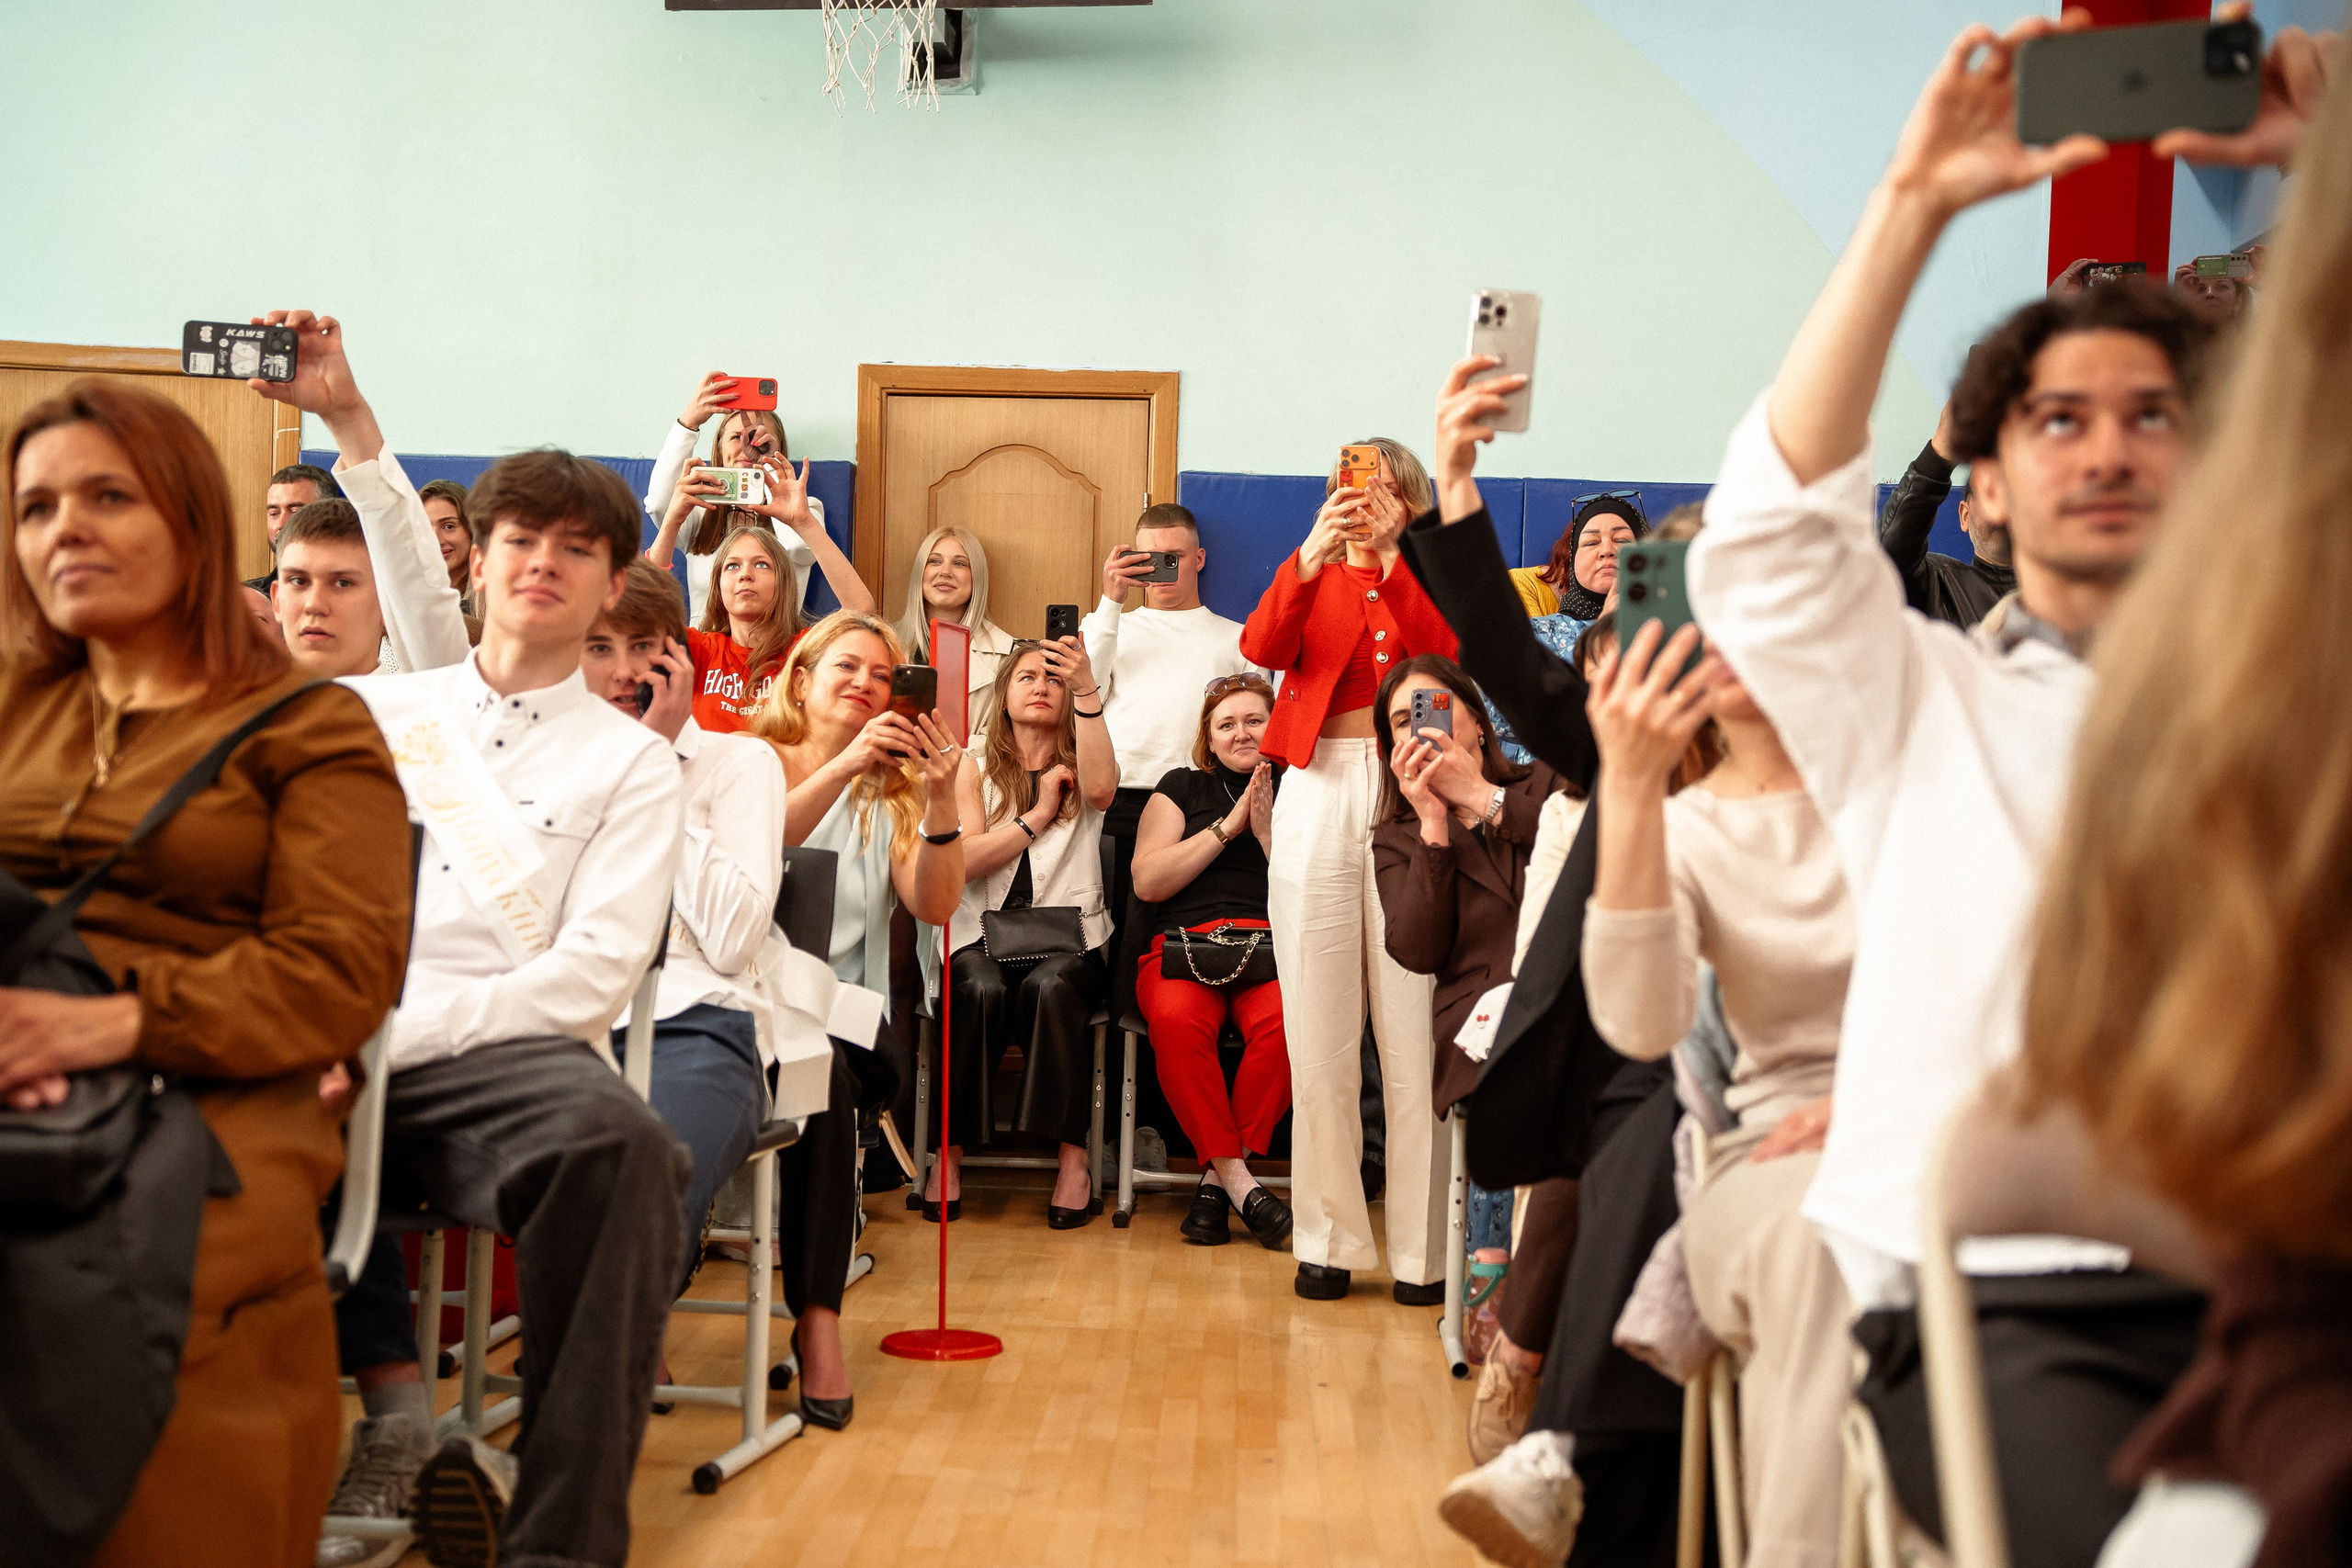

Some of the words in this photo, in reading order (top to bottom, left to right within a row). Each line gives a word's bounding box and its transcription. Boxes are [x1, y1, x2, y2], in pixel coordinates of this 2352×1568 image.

[226, 328, 266, 339] KAWS
[703, 668, 744, 700] HIGH
[720, 701, 737, 714] THE
